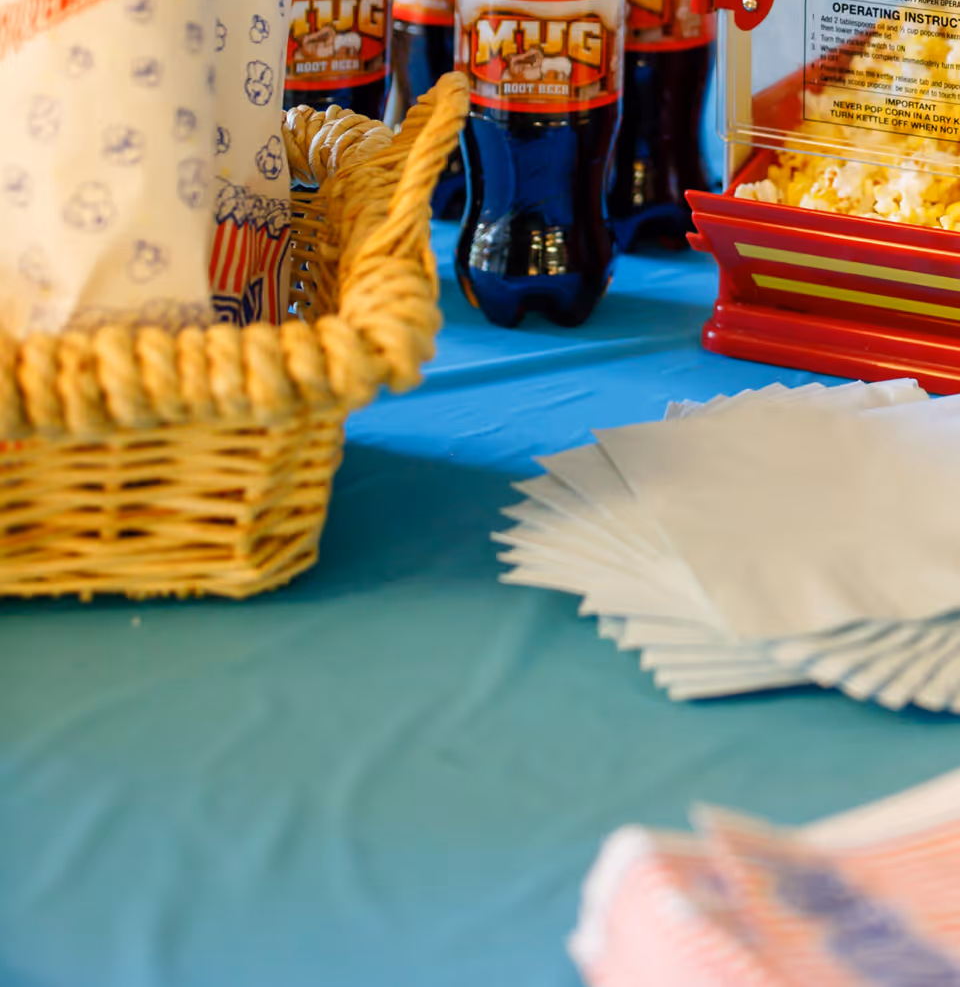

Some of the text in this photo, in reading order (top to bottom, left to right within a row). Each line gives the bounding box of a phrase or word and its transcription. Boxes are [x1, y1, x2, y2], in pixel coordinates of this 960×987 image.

[832, 2, 900, 21] OPERATING
[820, 15, 833, 23] Add
[834, 16, 839, 24] 2
[886, 24, 898, 32] and
[906, 27, 919, 35] cup
[919, 29, 946, 39] popcorn
[820, 24, 834, 32] then
[835, 26, 853, 34] lower
[475, 18, 602, 68] MUG
[820, 34, 834, 43] Turn
[835, 36, 845, 44] the
[941, 61, 955, 70] turn
[895, 74, 918, 84] release
[919, 78, 930, 86] tab
[930, 79, 943, 88] and
[503, 83, 569, 96] ROOT BEER
[919, 88, 930, 96] not
[938, 91, 957, 100] touch
[832, 100, 862, 111] NEVER
[864, 105, 883, 114] POP
[884, 108, 911, 119] CORN
[912, 112, 922, 120] IN
[932, 115, 952, 124] DRY
[885, 98, 937, 112] IMPORTANT
[829, 109, 854, 119] TURN
[855, 114, 889, 125] KETTLE
[890, 119, 909, 127] OFF
[910, 122, 938, 133] WHEN
[939, 126, 959, 135] NOT
